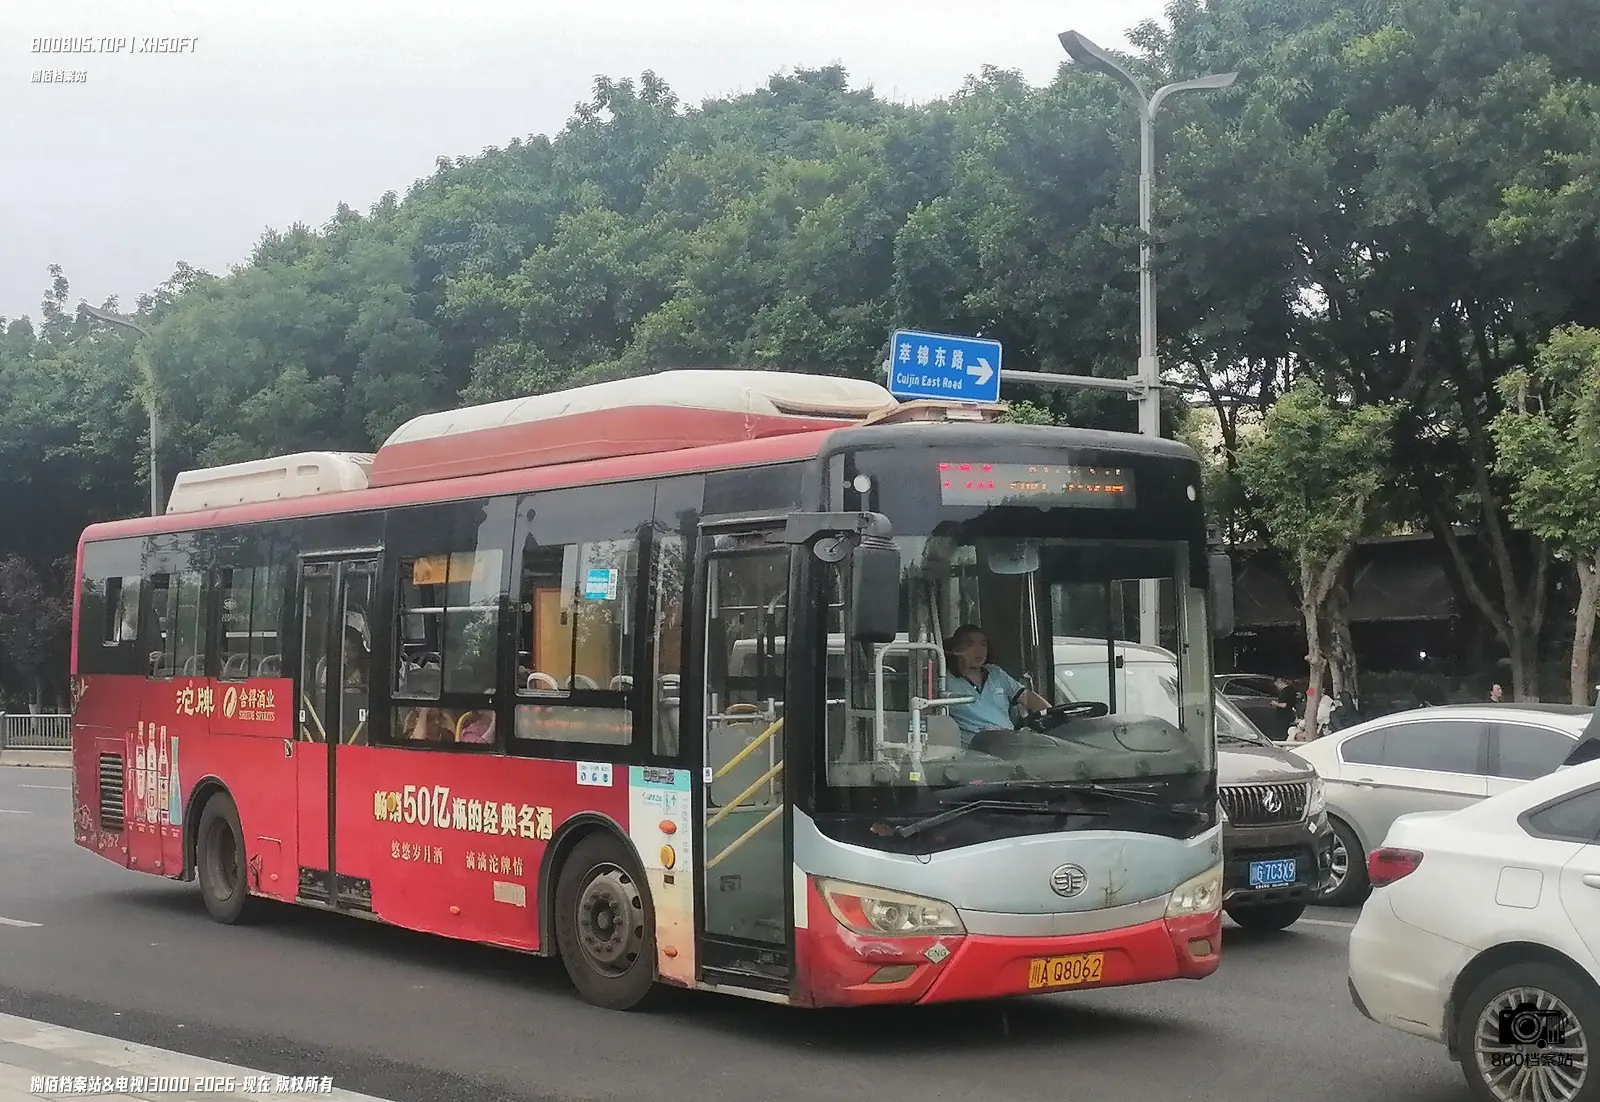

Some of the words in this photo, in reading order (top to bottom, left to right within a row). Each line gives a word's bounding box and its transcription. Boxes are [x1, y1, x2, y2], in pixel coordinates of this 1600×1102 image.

[899, 343, 964, 370] 萃锦东路
[897, 372, 919, 388] Cuijin
[921, 375, 940, 388] East
[942, 377, 963, 390] Road
[239, 687, 275, 708] 舍得酒业
